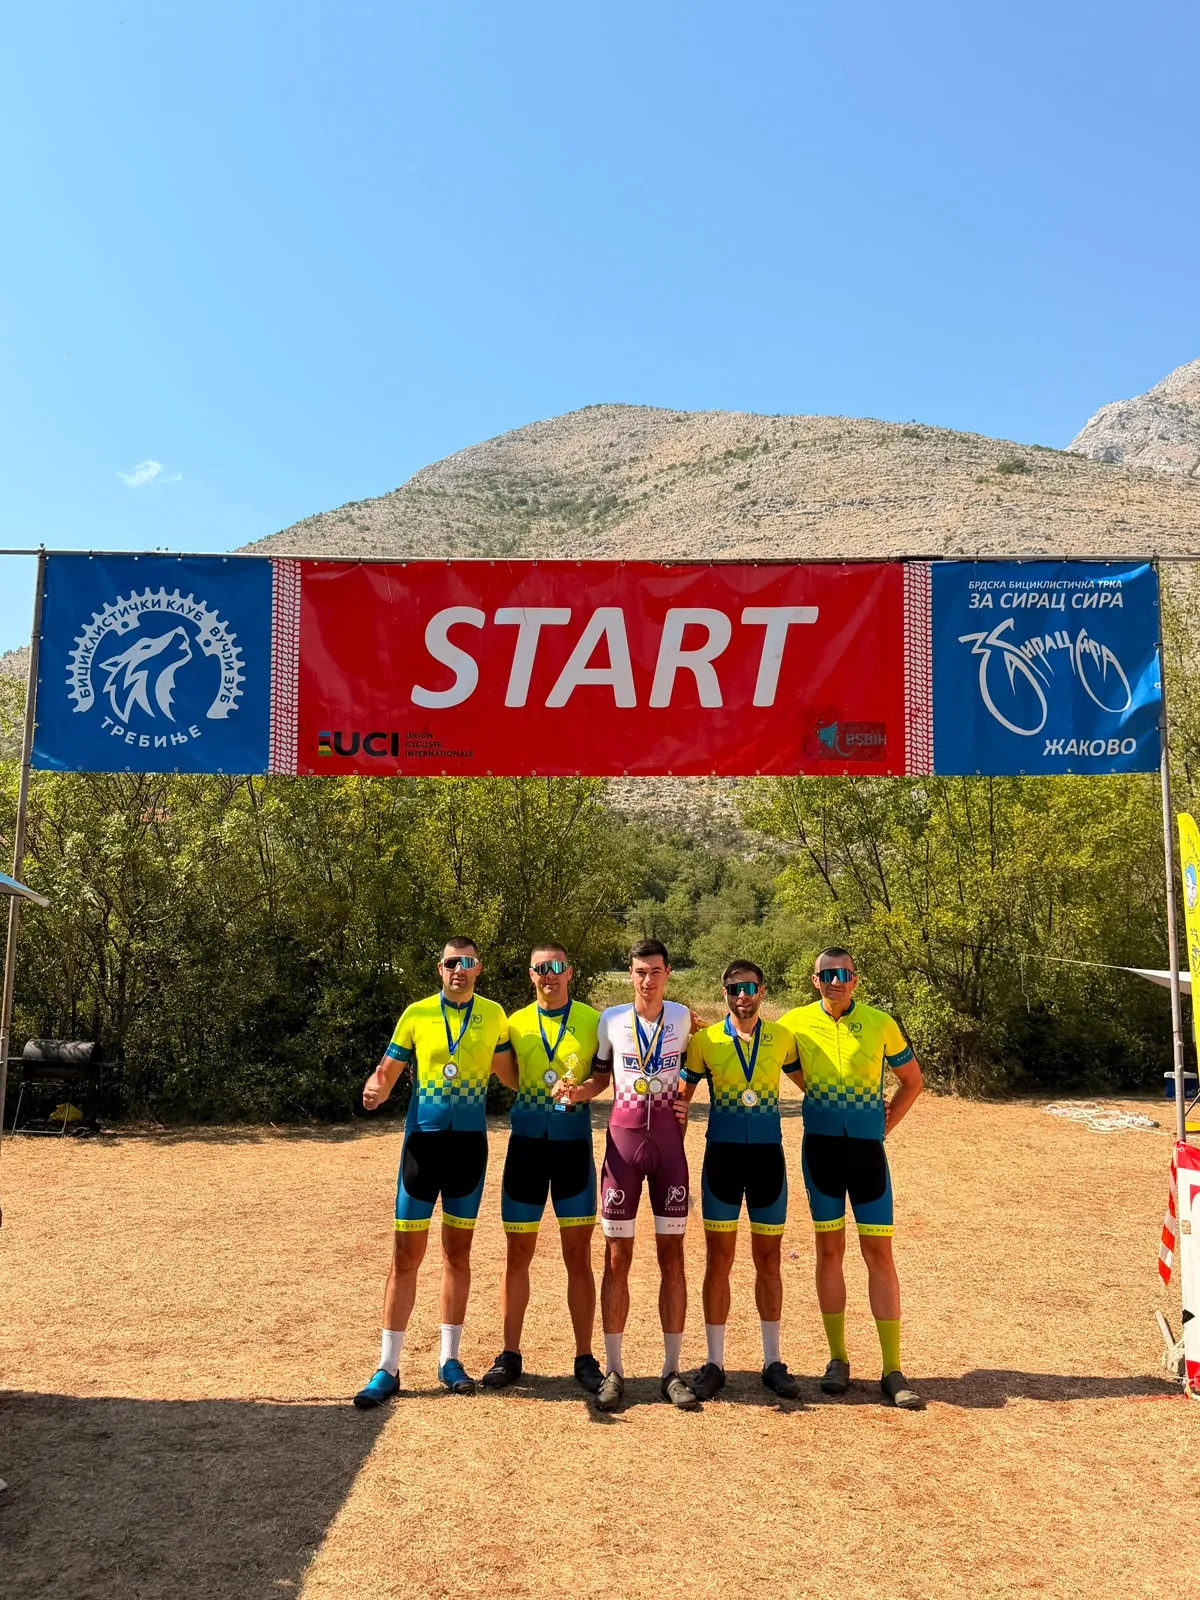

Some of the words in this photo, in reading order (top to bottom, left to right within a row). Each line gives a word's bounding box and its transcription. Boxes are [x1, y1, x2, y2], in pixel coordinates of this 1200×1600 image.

[968, 580, 1007, 591] БРДСКА
[1008, 580, 1095, 591] БИЦИКЛИСТИЧКА
[1097, 580, 1123, 589] ТРКА
[166, 599, 205, 621] КЛУБ
[968, 593, 993, 609] ЗА
[999, 592, 1066, 611] СИРАЦ
[1071, 592, 1124, 609] СИРА
[76, 599, 162, 699] БИЦИКЛИСТИЧКИ
[209, 626, 235, 671] ВУЧЈИ
[411, 606, 819, 709] START
[219, 676, 235, 704] ЗУБ
[101, 716, 202, 748] ТРЕБИЊЕ
[333, 731, 399, 757] UCI
[846, 733, 887, 746] BSBIH
[405, 750, 474, 758] INTERNATIONALE
[1042, 738, 1137, 756] ЖАКОВО
